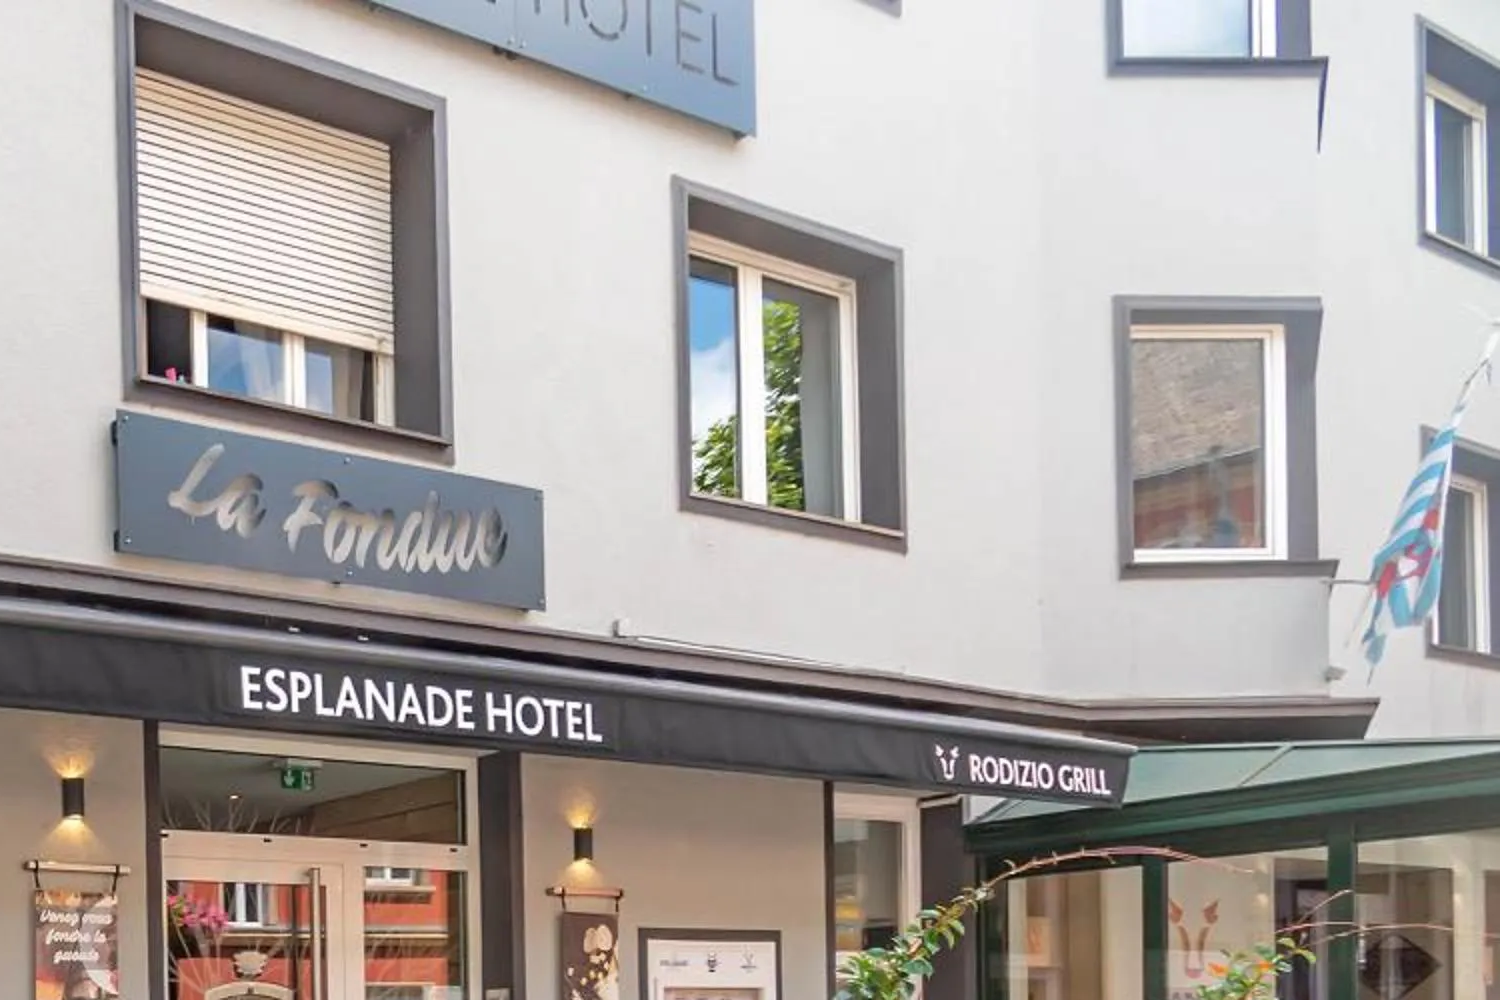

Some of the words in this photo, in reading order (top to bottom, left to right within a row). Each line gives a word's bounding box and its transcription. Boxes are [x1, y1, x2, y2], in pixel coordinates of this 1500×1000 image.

[168, 443, 266, 539] La
[283, 479, 508, 573] Fondue
[240, 666, 475, 729] ESPLANADE
[486, 692, 603, 742] HOTEL
[969, 754, 1055, 789] RODIZIO
[1058, 765, 1111, 795] GRILL
